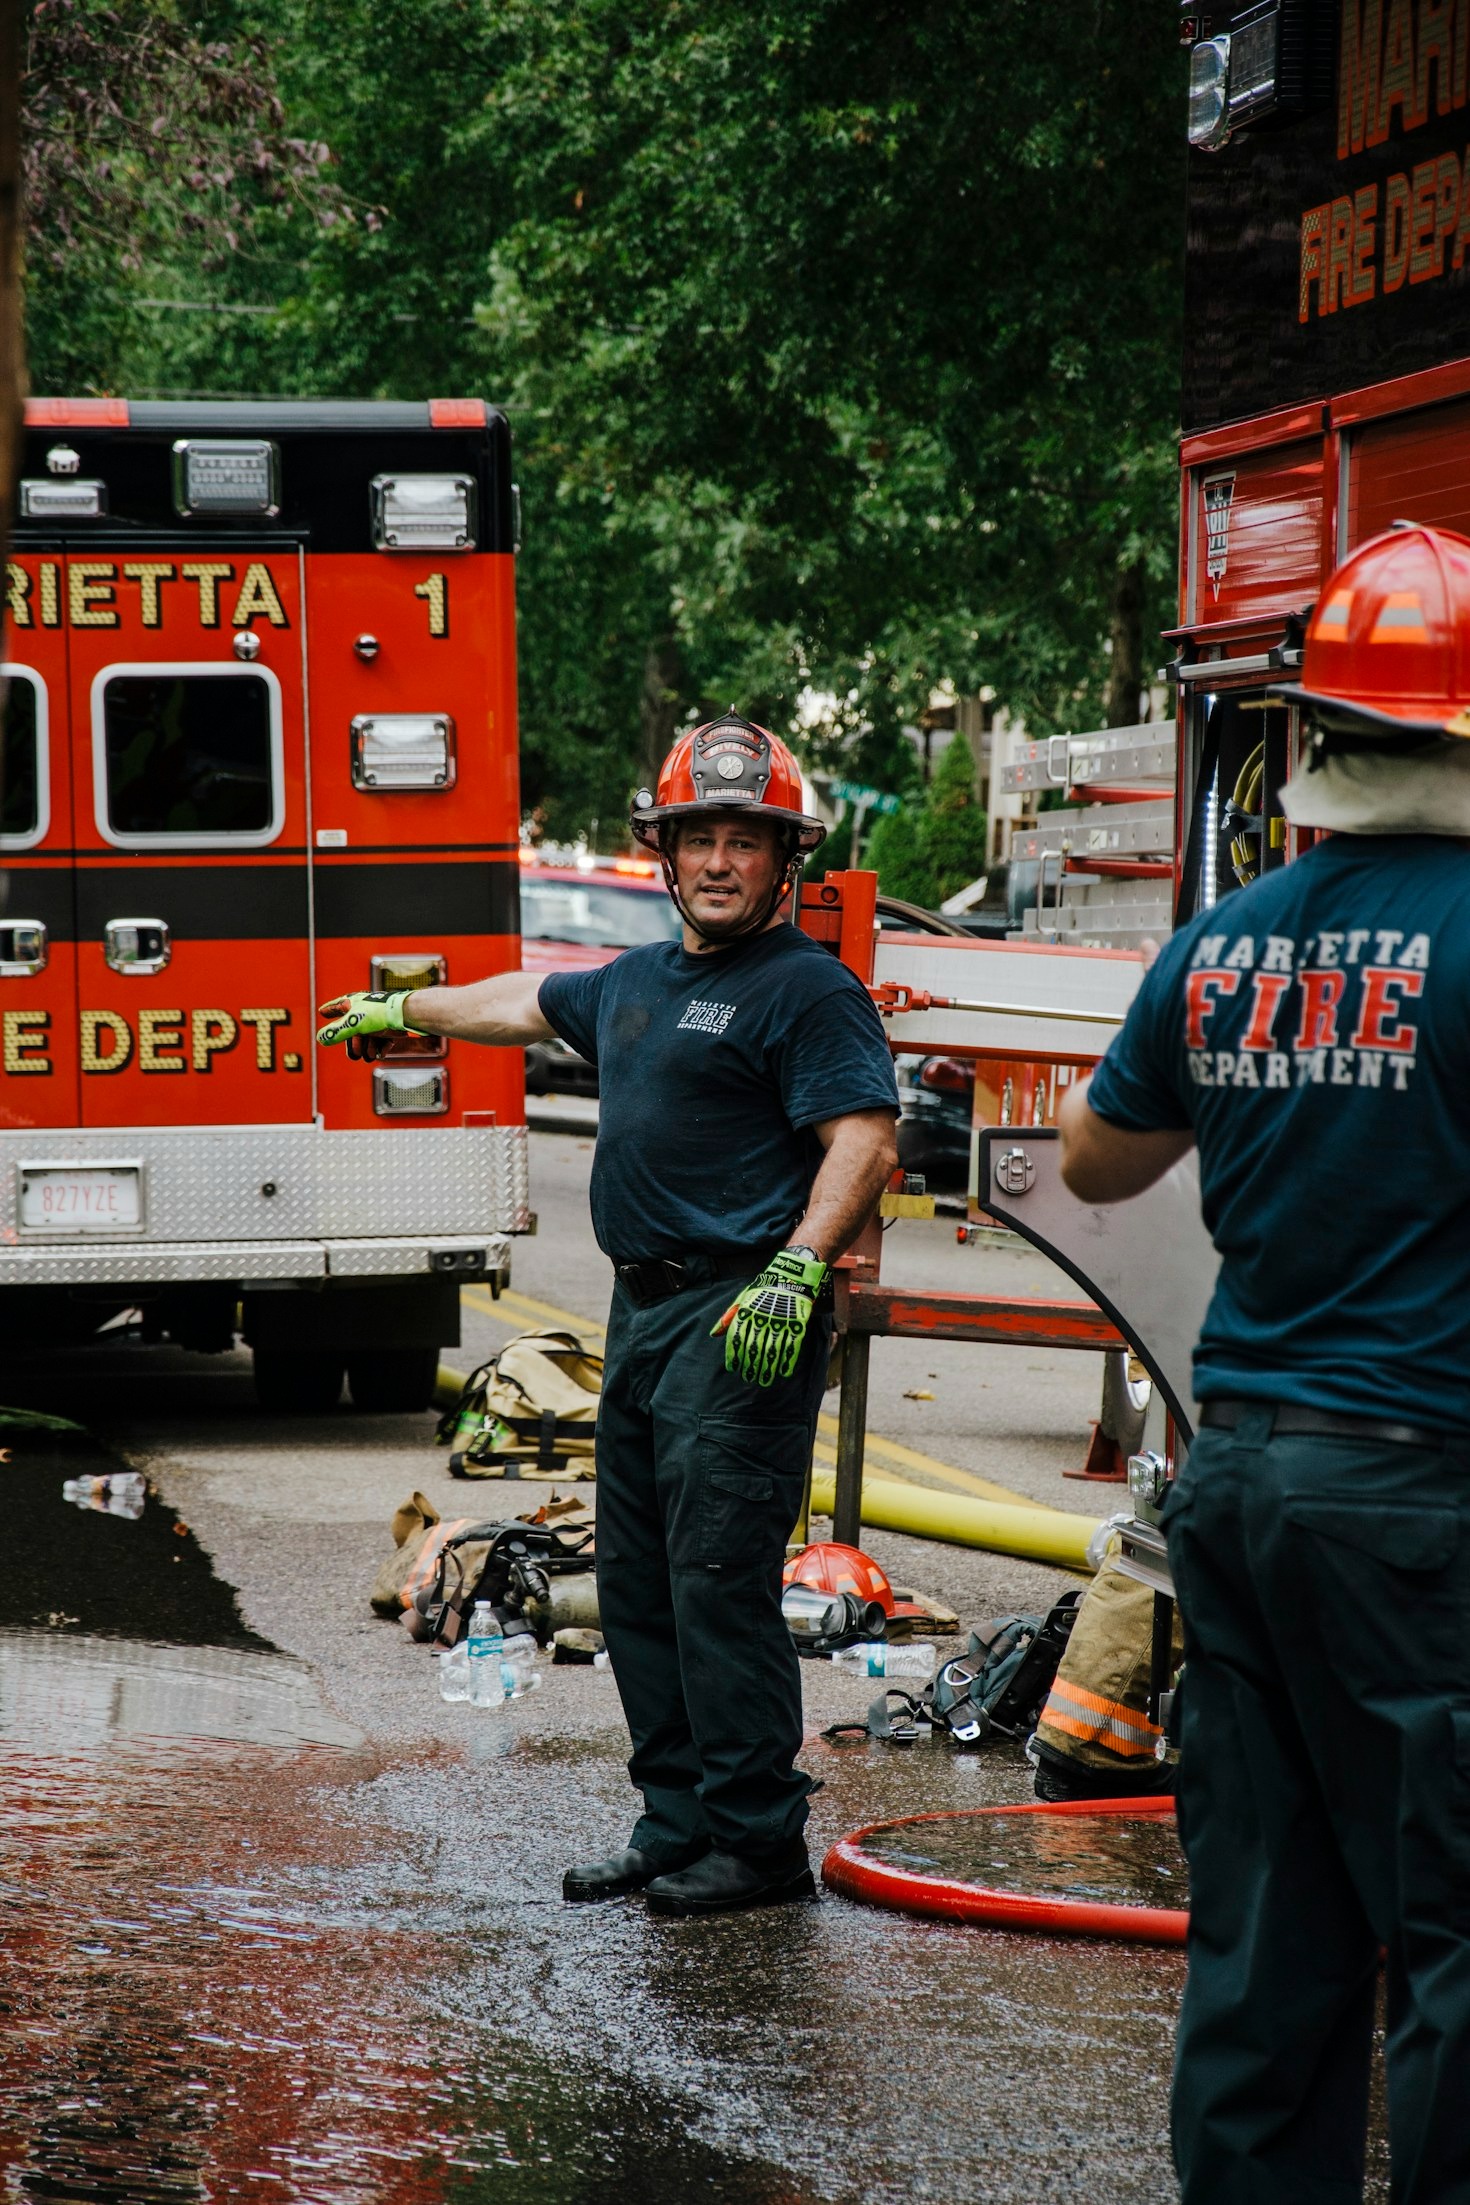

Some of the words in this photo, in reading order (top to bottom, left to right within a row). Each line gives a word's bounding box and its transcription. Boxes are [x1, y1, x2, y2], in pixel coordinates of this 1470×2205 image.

[1298, 182, 1378, 325] FIRE
[414, 573, 449, 639] 1
[709, 726, 754, 740] FIREFIGHTER
[706, 788, 752, 799] MARIETTA
[680, 1006, 733, 1029] FIRE
[1186, 967, 1426, 1053] FIRE
[80, 1008, 302, 1074] DEPT.
[677, 1023, 723, 1034] DEPARTMENT
[42, 1184, 119, 1213] 827YZE
